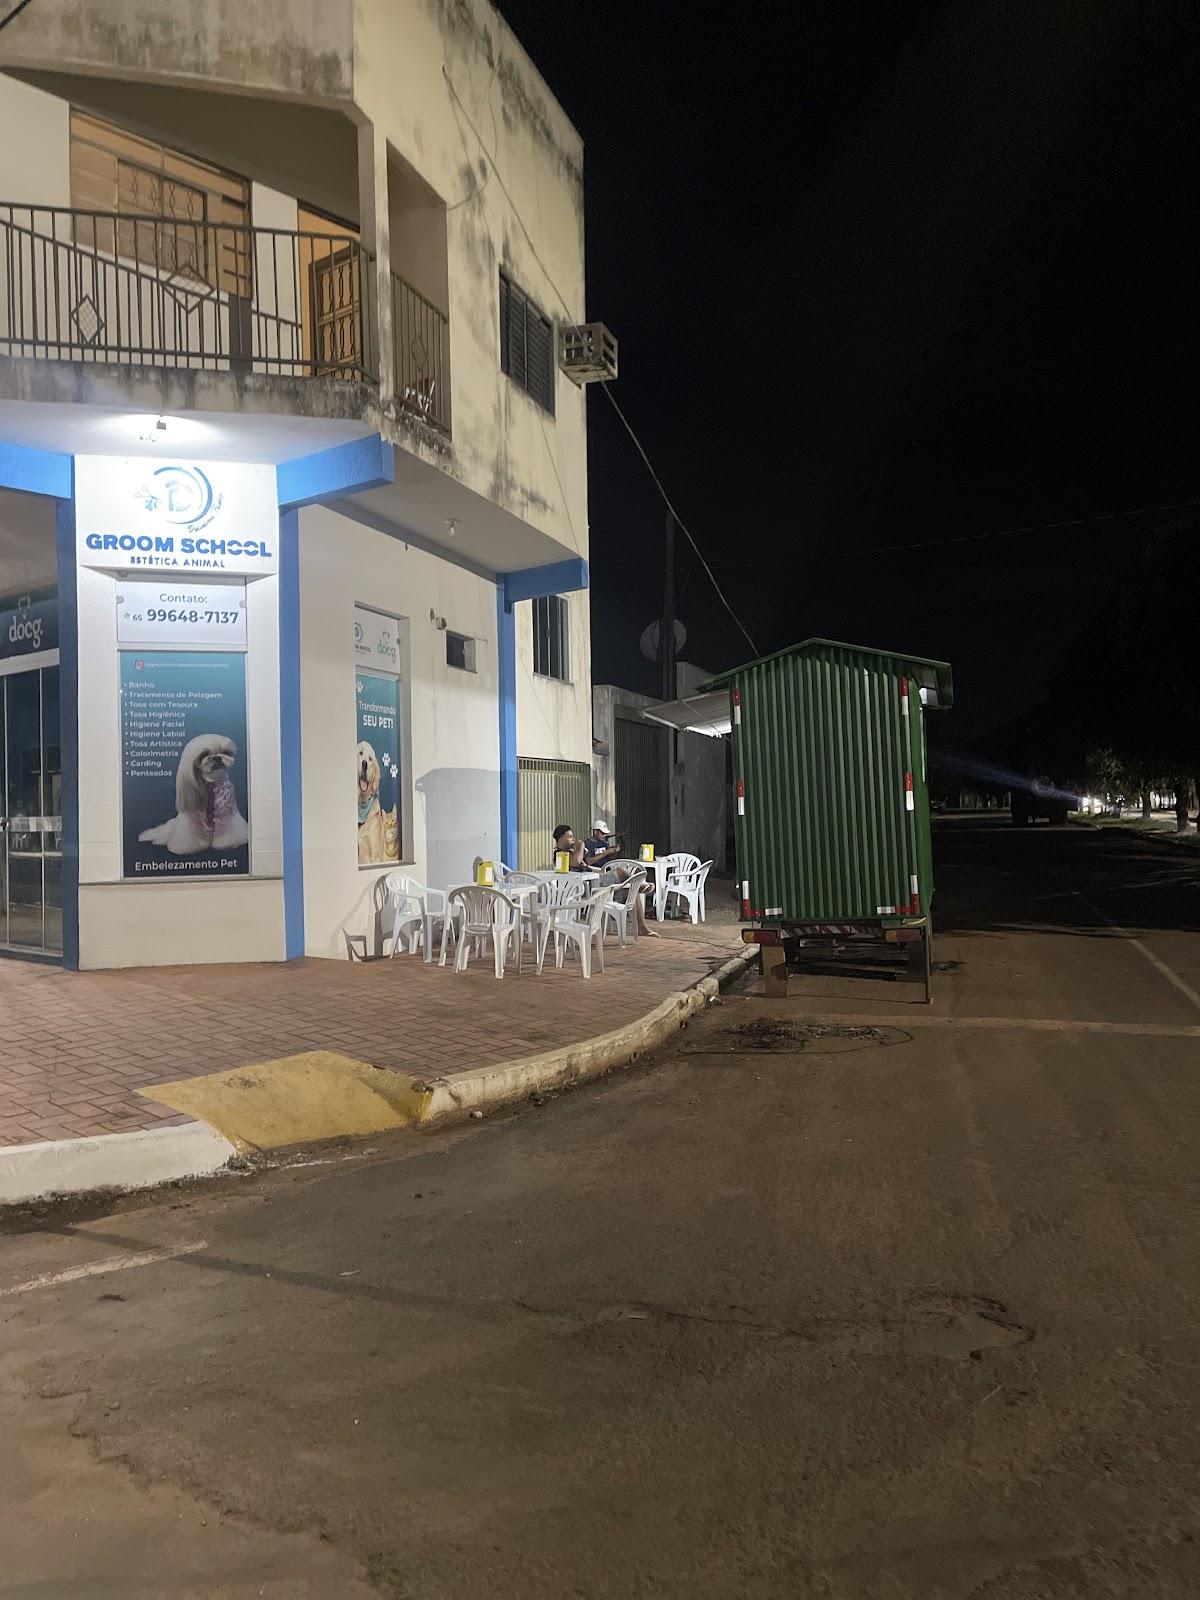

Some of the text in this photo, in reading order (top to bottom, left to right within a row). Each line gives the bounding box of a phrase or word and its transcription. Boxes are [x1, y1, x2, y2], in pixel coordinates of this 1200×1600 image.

[86, 533, 272, 558] GROOM SCHOOL
[130, 555, 226, 568] ESTÉTICA ANIMAL
[159, 592, 208, 604] Contato:
[147, 608, 239, 624] 99648-7137
[188, 692, 222, 700] Pelagem
[168, 701, 198, 709] Tesoura
[358, 700, 396, 716] Transformando
[149, 711, 186, 719] Higiênica
[129, 721, 160, 729] Higiene
[362, 714, 394, 729] SEU PET!
[130, 731, 160, 739] Higiene
[130, 760, 162, 768] Carding
[135, 859, 238, 871] Embelezamento Pet
